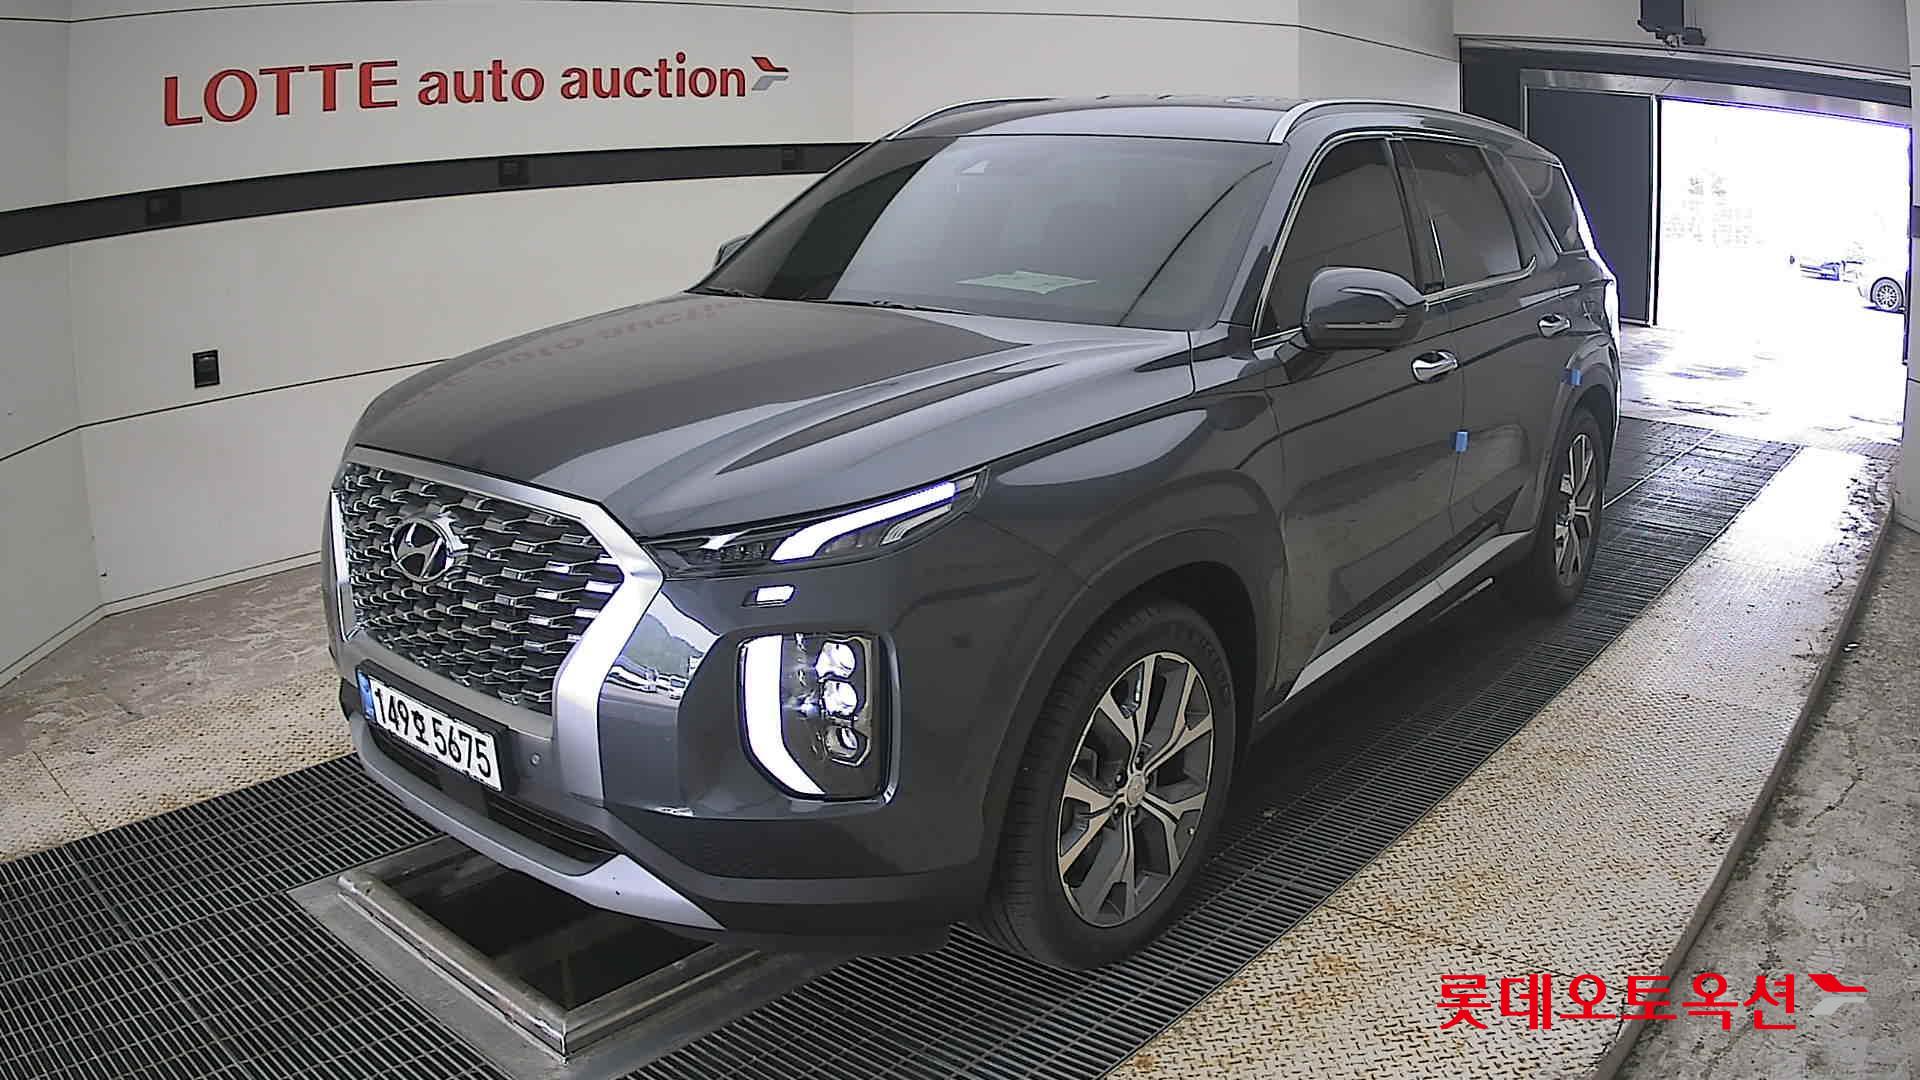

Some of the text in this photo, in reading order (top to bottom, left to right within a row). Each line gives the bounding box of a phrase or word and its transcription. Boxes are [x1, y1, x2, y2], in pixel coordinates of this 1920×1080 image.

[163, 51, 746, 126] LOTTE auto auction
[431, 717, 492, 778] 5675
